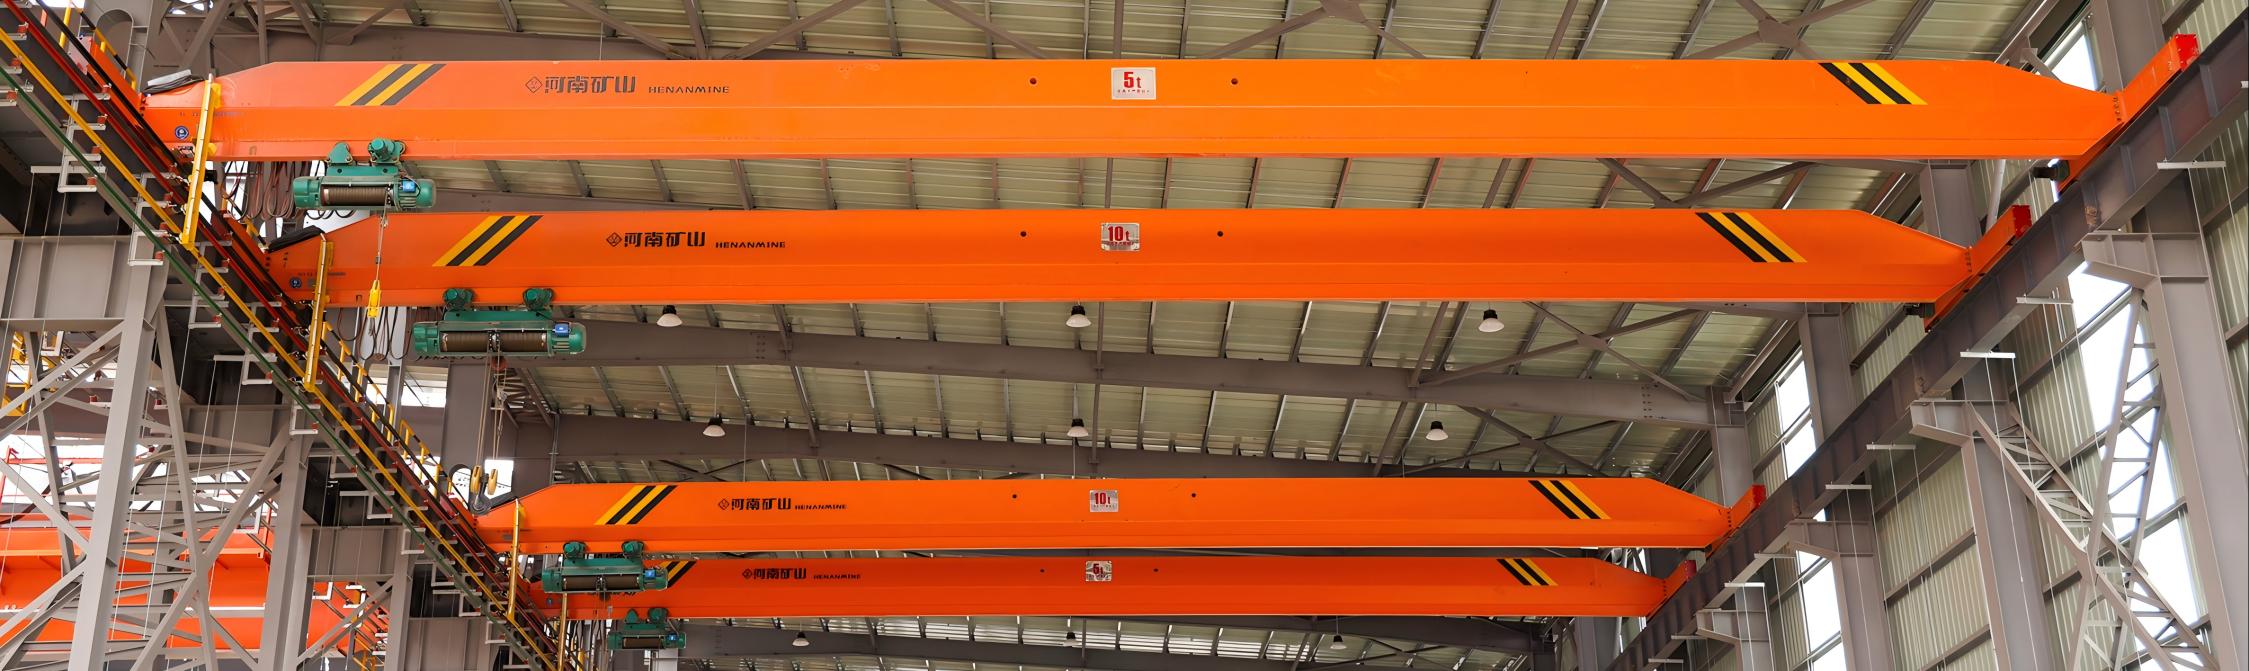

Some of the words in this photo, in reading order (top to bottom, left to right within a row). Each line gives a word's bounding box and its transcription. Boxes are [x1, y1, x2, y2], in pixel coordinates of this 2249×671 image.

[545, 75, 636, 94] 河南矿山
[648, 86, 730, 94] HENANMINE
[624, 231, 706, 248] 河南矿山
[715, 241, 786, 249] HENANMINE
[731, 497, 791, 511] 河南矿山
[753, 567, 807, 580] 河南矿山
